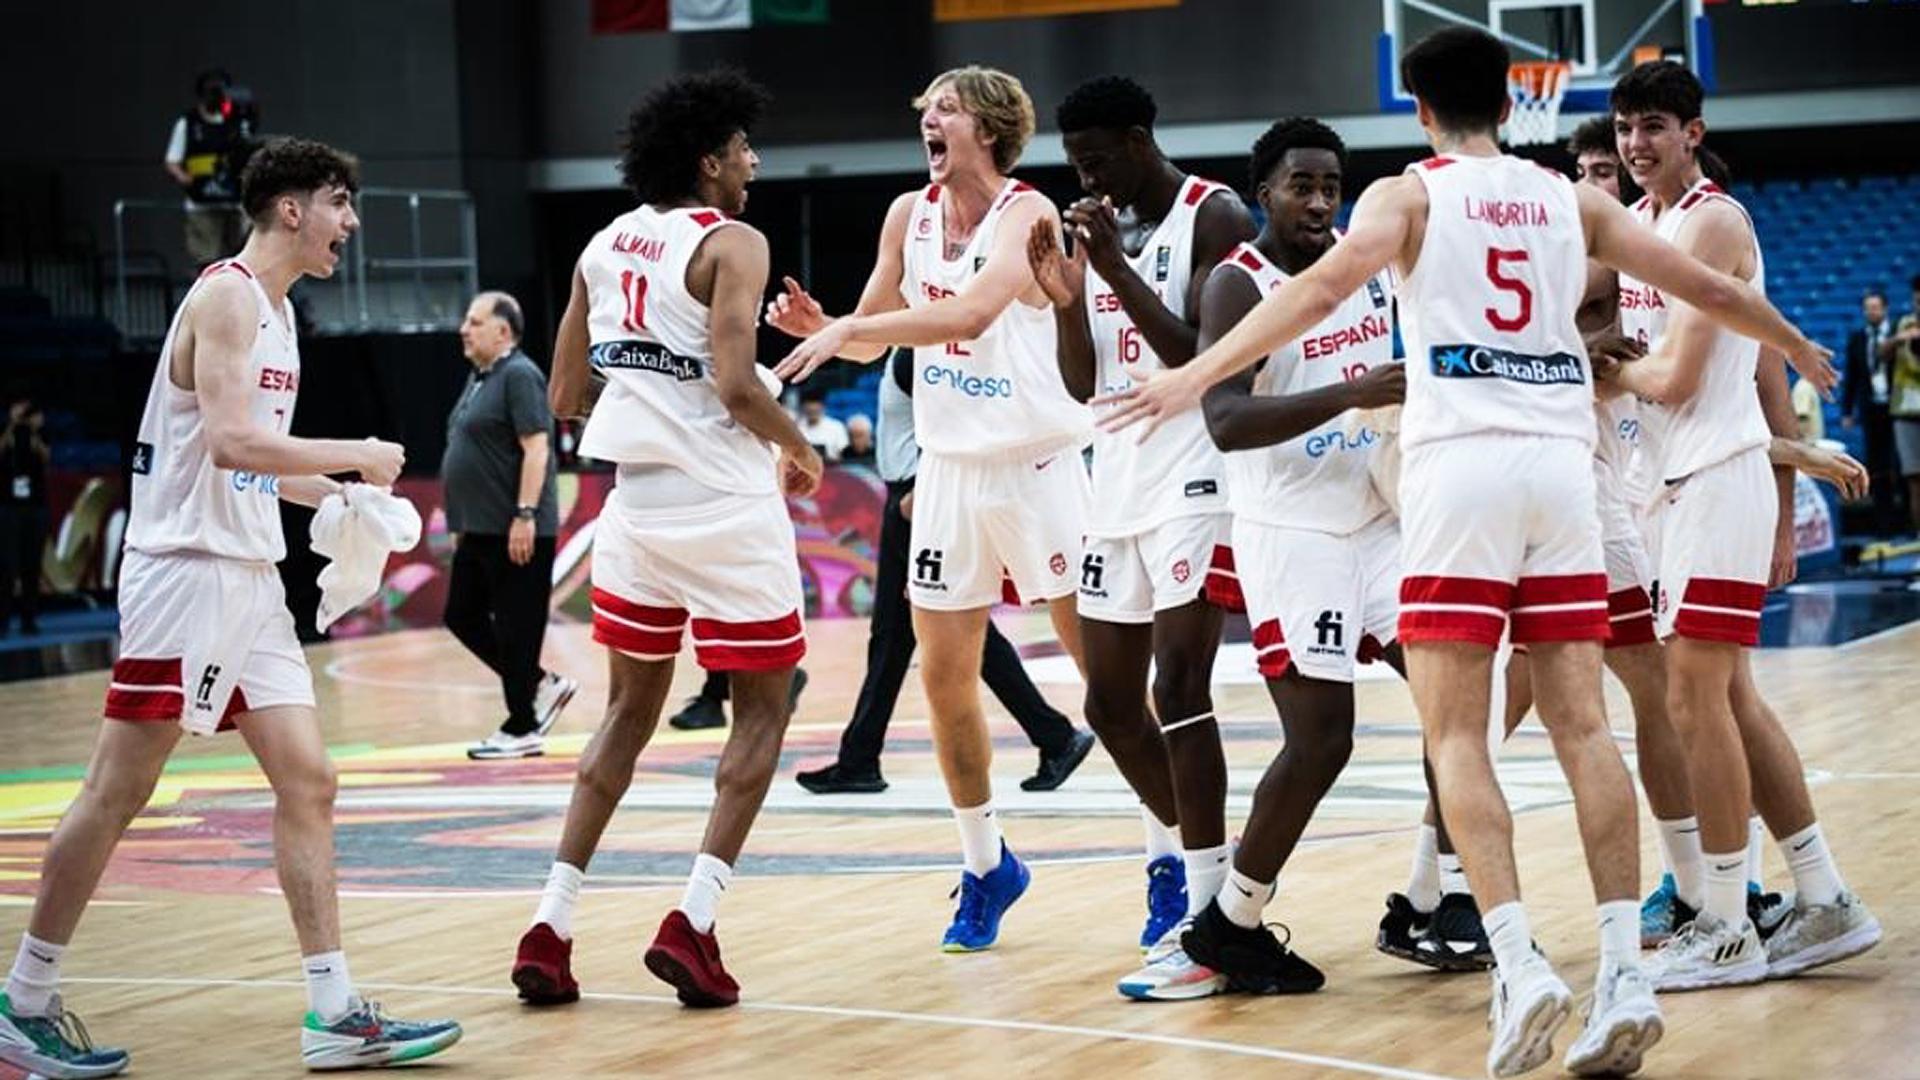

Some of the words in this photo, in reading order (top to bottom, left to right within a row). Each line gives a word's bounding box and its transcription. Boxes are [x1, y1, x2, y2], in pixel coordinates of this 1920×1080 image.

[621, 270, 648, 331] 11
[1095, 294, 1125, 313] ES
[1485, 247, 1532, 333] 5
[1117, 327, 1142, 364] 16
[1303, 315, 1389, 360] ESPAÑA
[1469, 349, 1582, 382] CaixaBank
[915, 548, 943, 582] fi
[1082, 553, 1103, 589] fi
[1314, 610, 1342, 646] fi
